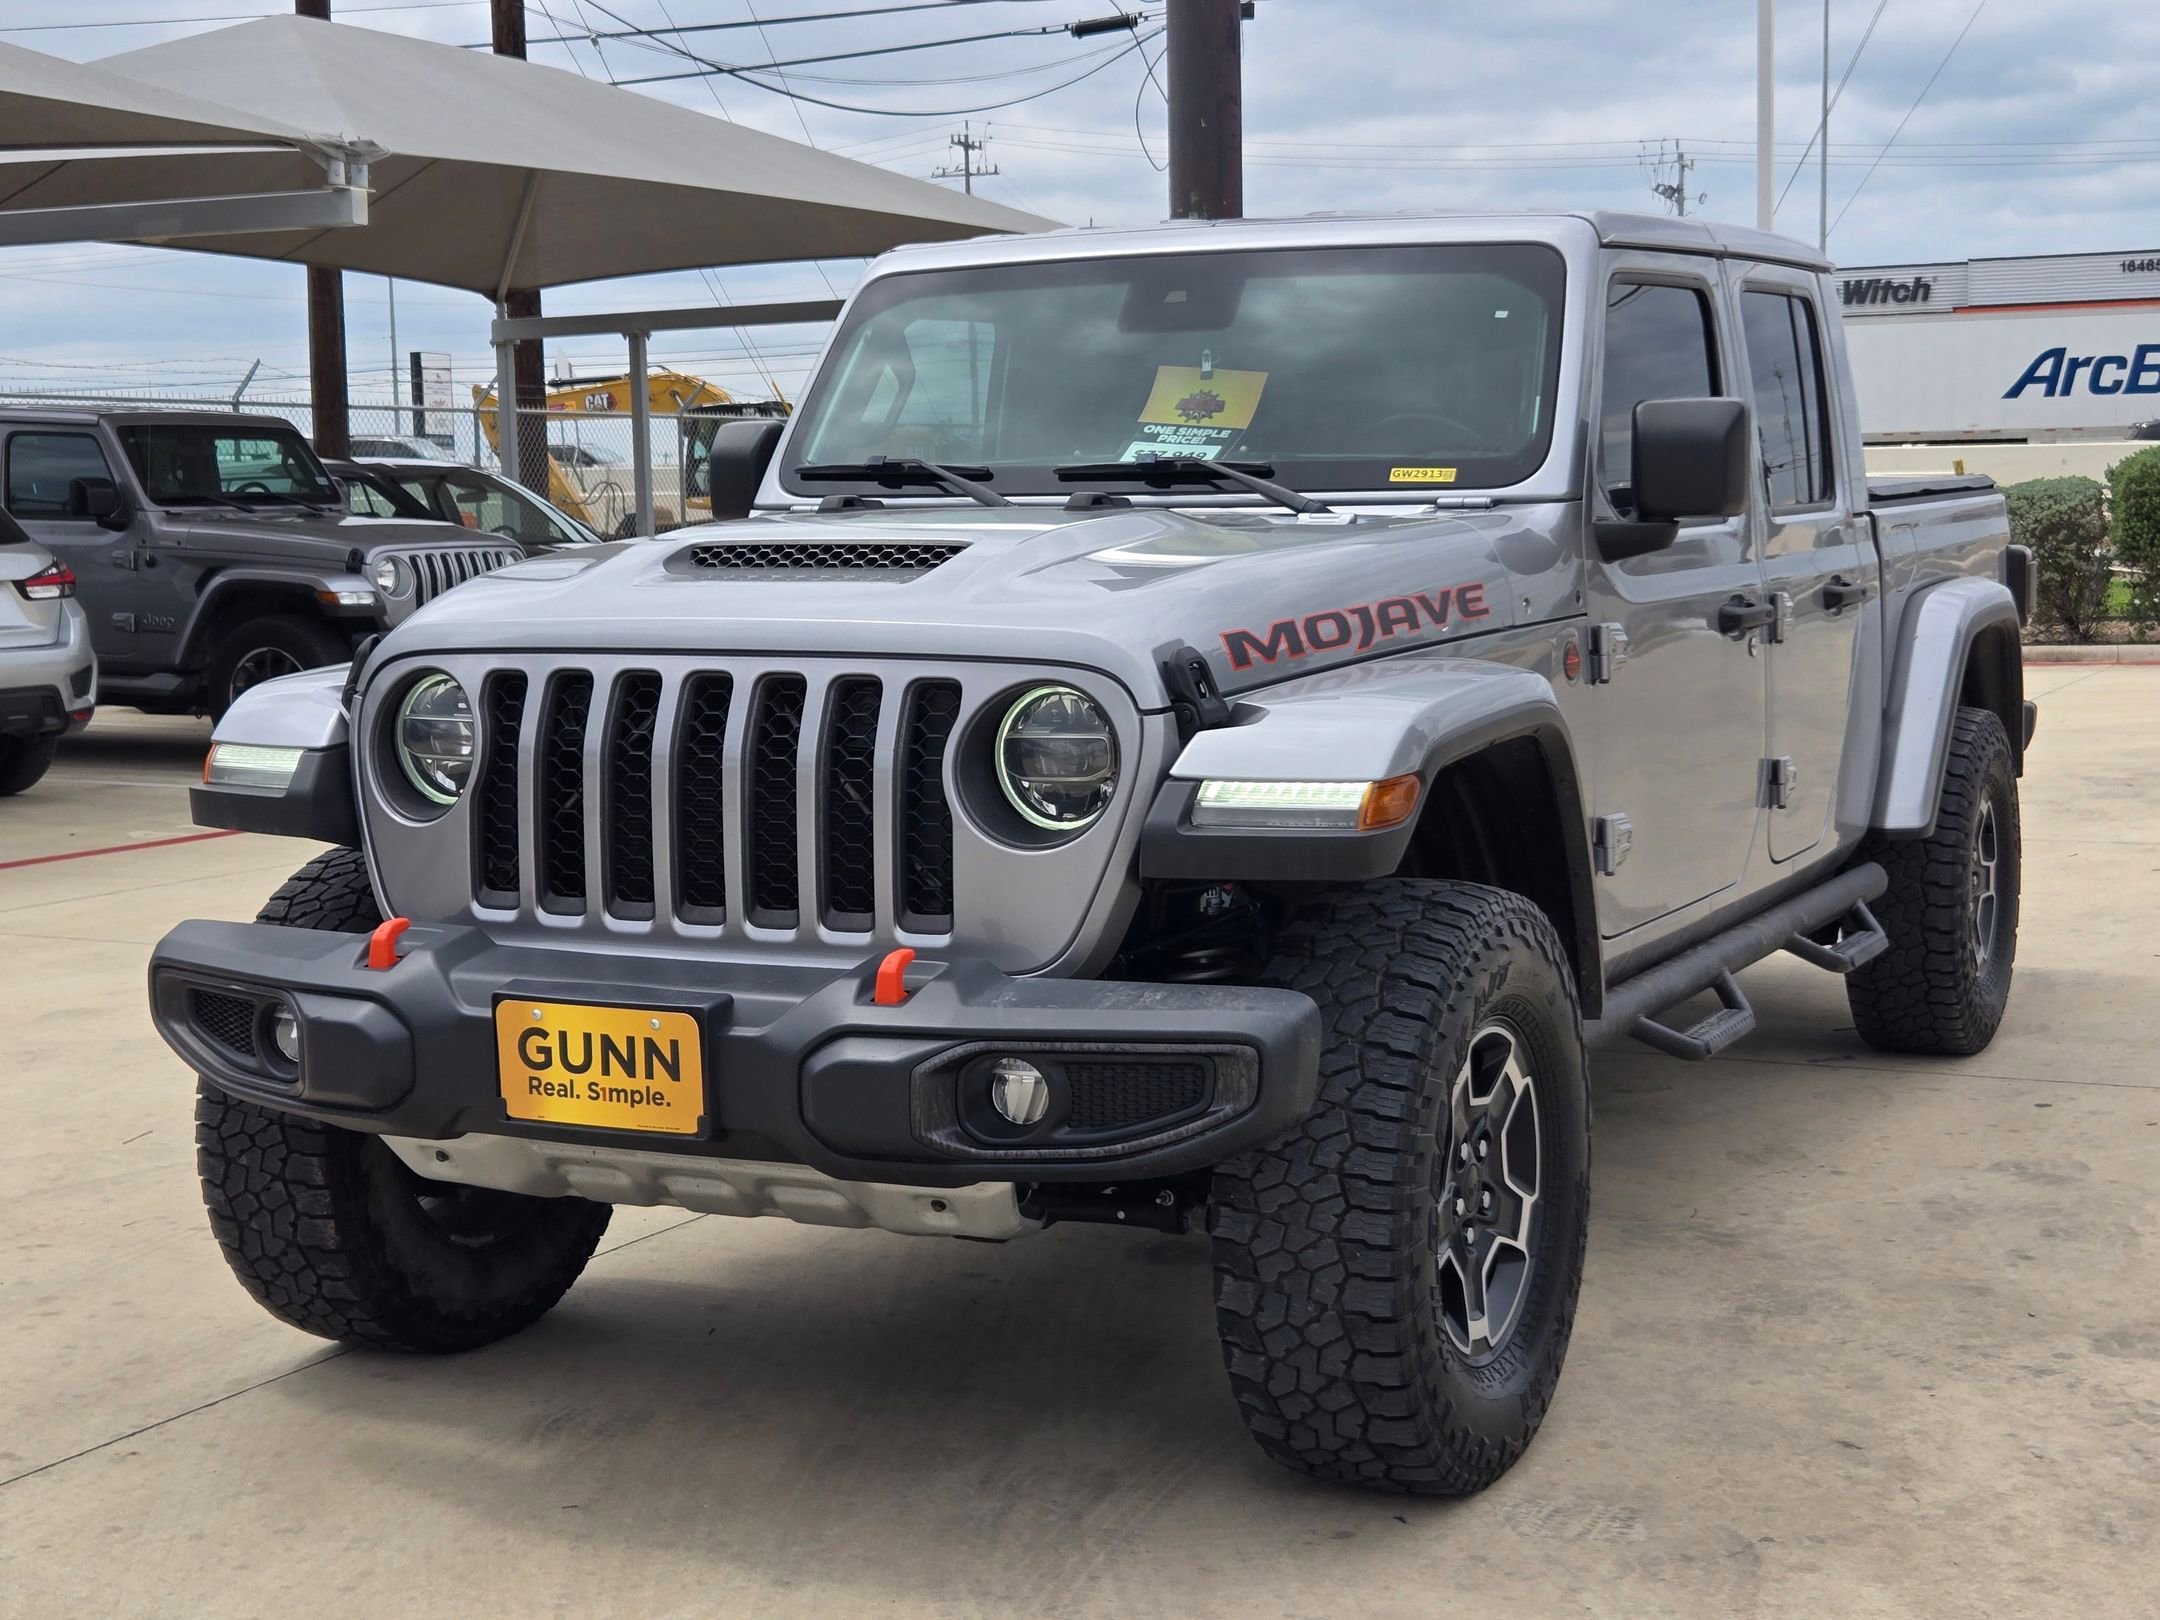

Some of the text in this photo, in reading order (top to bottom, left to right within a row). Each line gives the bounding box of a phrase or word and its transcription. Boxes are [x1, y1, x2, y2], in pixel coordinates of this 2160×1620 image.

[1843, 277, 1932, 305] Witch
[2001, 344, 2160, 399] ArcB
[585, 393, 609, 412] CAT
[1143, 425, 1231, 438] ONE SIMPLE
[1156, 434, 1206, 444] PRICE!
[1219, 583, 1490, 672] MOJAVE
[517, 1026, 681, 1083] GUNN
[528, 1076, 581, 1100] Real.
